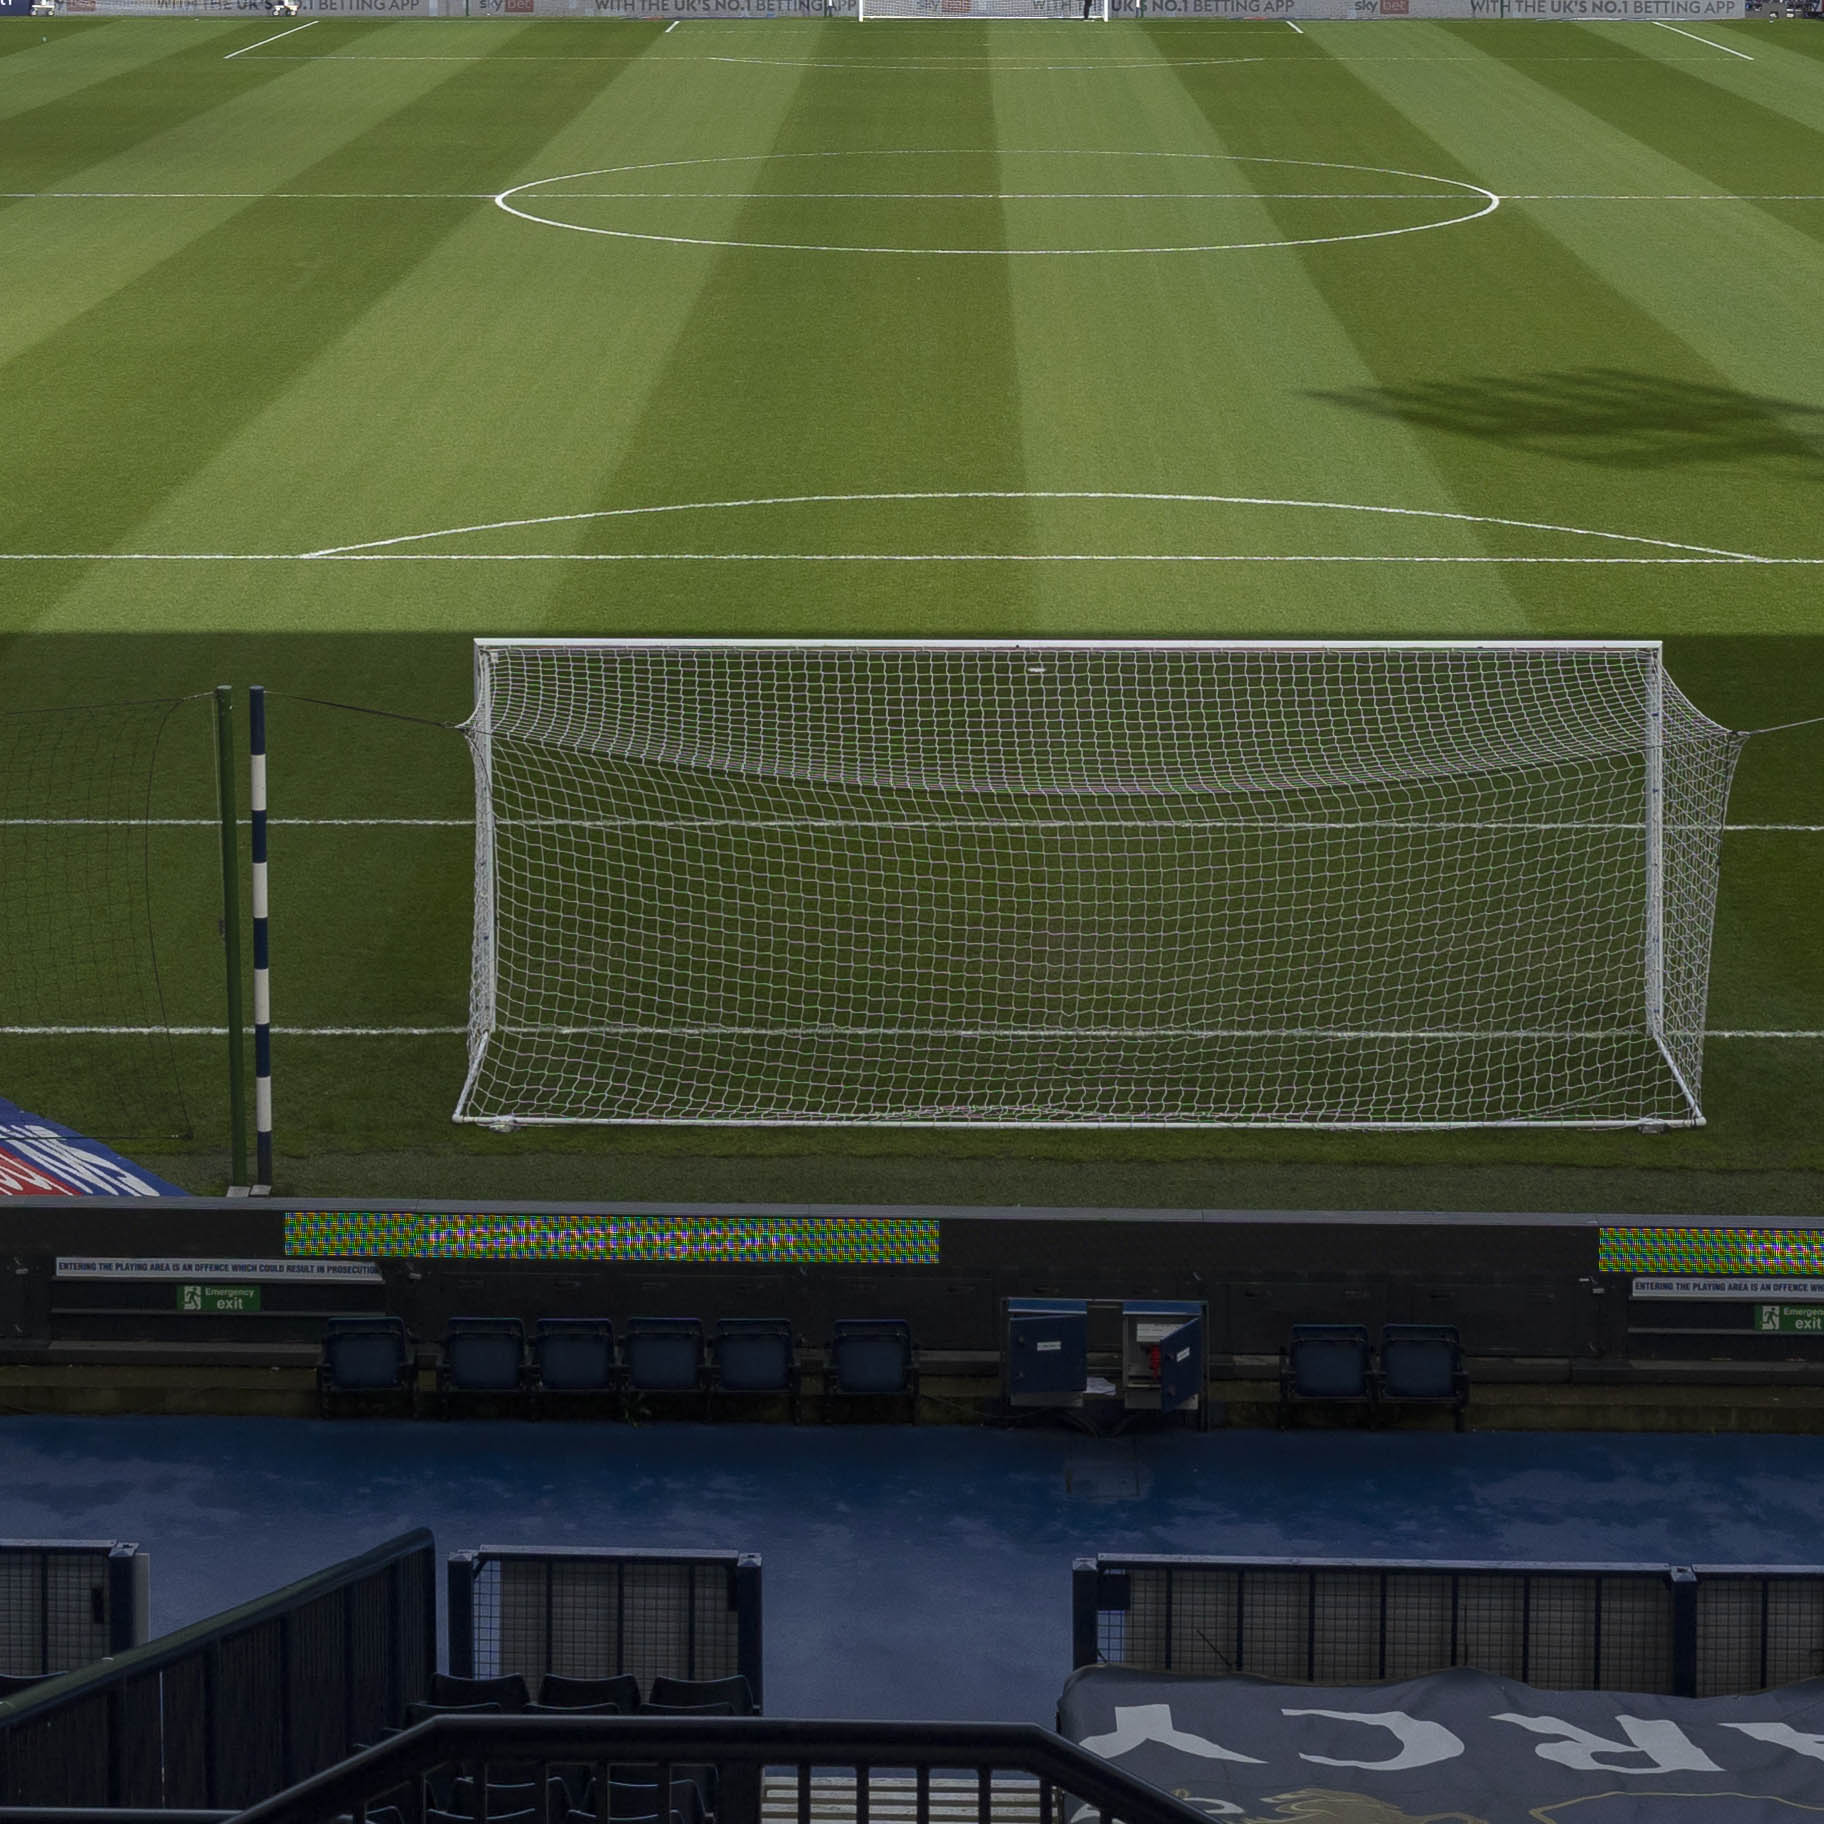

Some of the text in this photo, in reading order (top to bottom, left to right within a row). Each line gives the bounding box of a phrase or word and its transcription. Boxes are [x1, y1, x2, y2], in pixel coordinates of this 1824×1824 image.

[639, 0, 670, 11] THE
[674, 0, 711, 12] UK'S
[715, 0, 752, 12] NO.1
[756, 0, 823, 12] BETTING
[1152, 0, 1296, 12] NO.1 BETTING APP
[1470, 0, 1512, 13] WITH
[1515, 0, 1546, 13] THE
[1550, 0, 1588, 14] UK'S
[1591, 0, 1630, 14] NO.1
[1634, 0, 1701, 14] BETTING
[1703, 0, 1736, 14] APP
[58, 1261, 315, 1275] ENTERING THE PLAYING AREA OFFENCE WHICH COULD RESULT
[205, 1287, 255, 1298] Emergency
[1635, 1281, 1674, 1293] ENTERING
[1676, 1281, 1691, 1293] THE
[1692, 1281, 1726, 1294] PLAYING
[1727, 1281, 1749, 1294] AREA
[1750, 1282, 1759, 1294] IS
[1760, 1282, 1772, 1294] AN
[1772, 1282, 1809, 1295] OFFENCE
[216, 1297, 243, 1310] exit
[1795, 1318, 1822, 1330] exit
